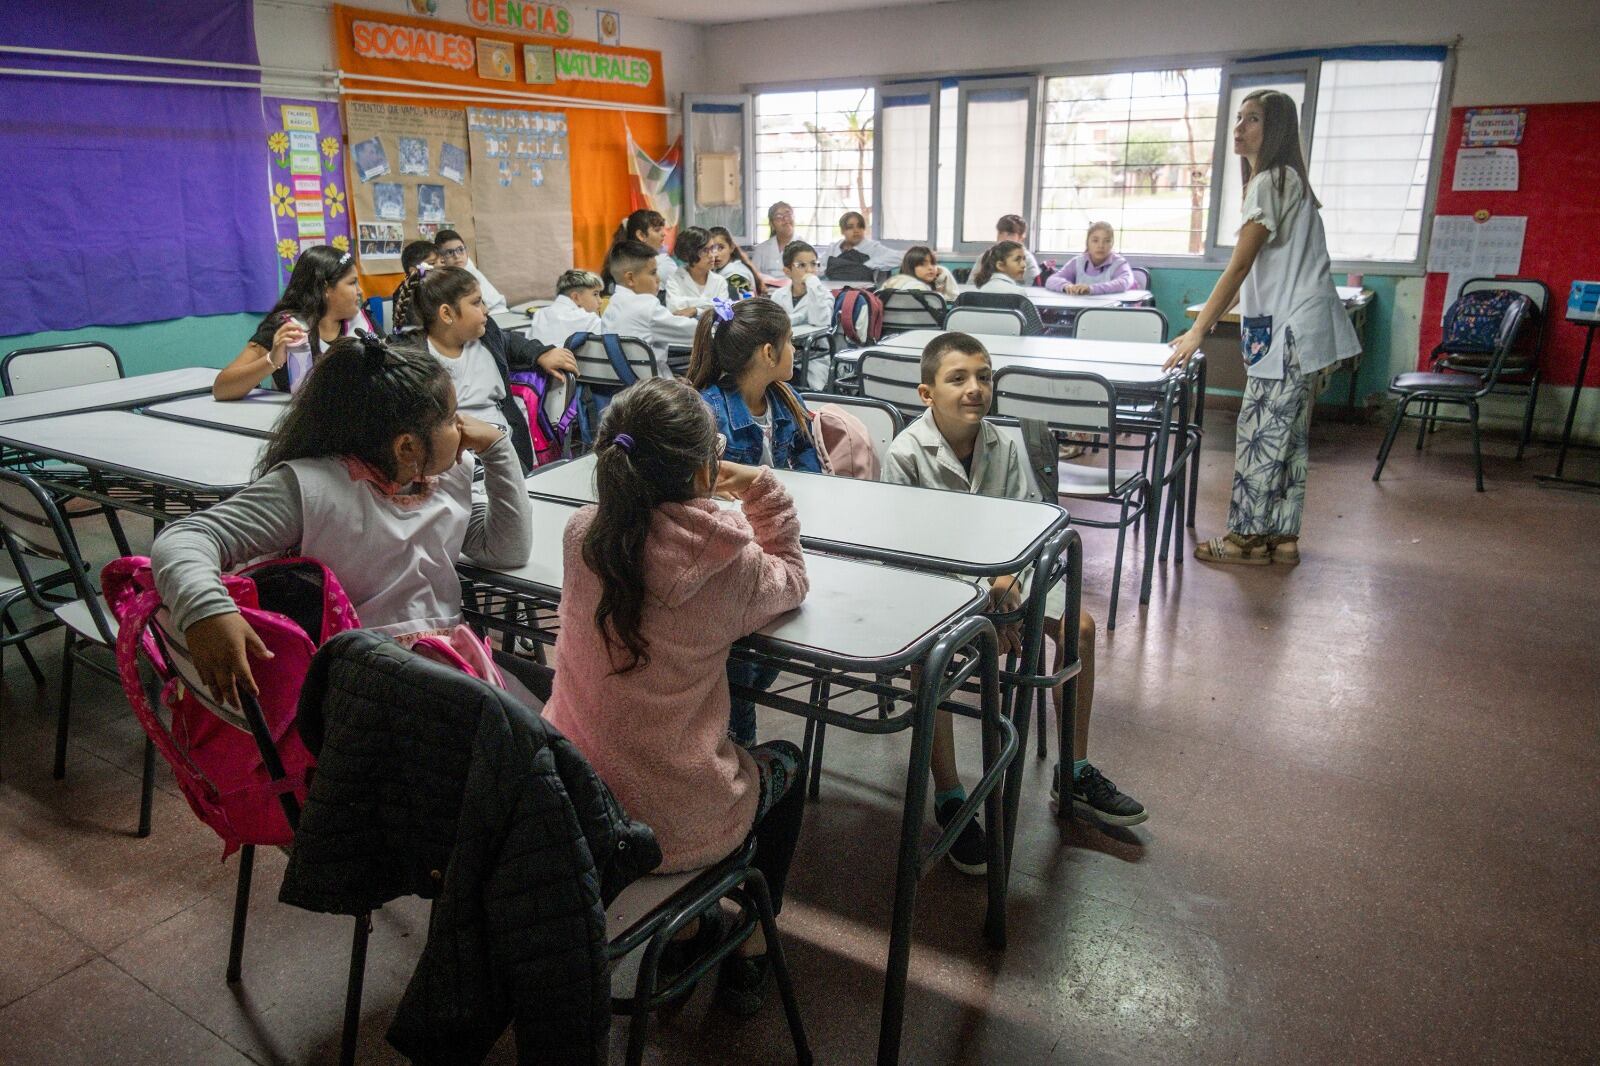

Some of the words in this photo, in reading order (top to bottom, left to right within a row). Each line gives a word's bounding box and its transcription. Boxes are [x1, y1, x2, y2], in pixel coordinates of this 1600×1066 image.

[472, 0, 570, 34] CIENCIAS
[354, 24, 473, 65] SOCIALES
[555, 50, 649, 84] NATURALES
